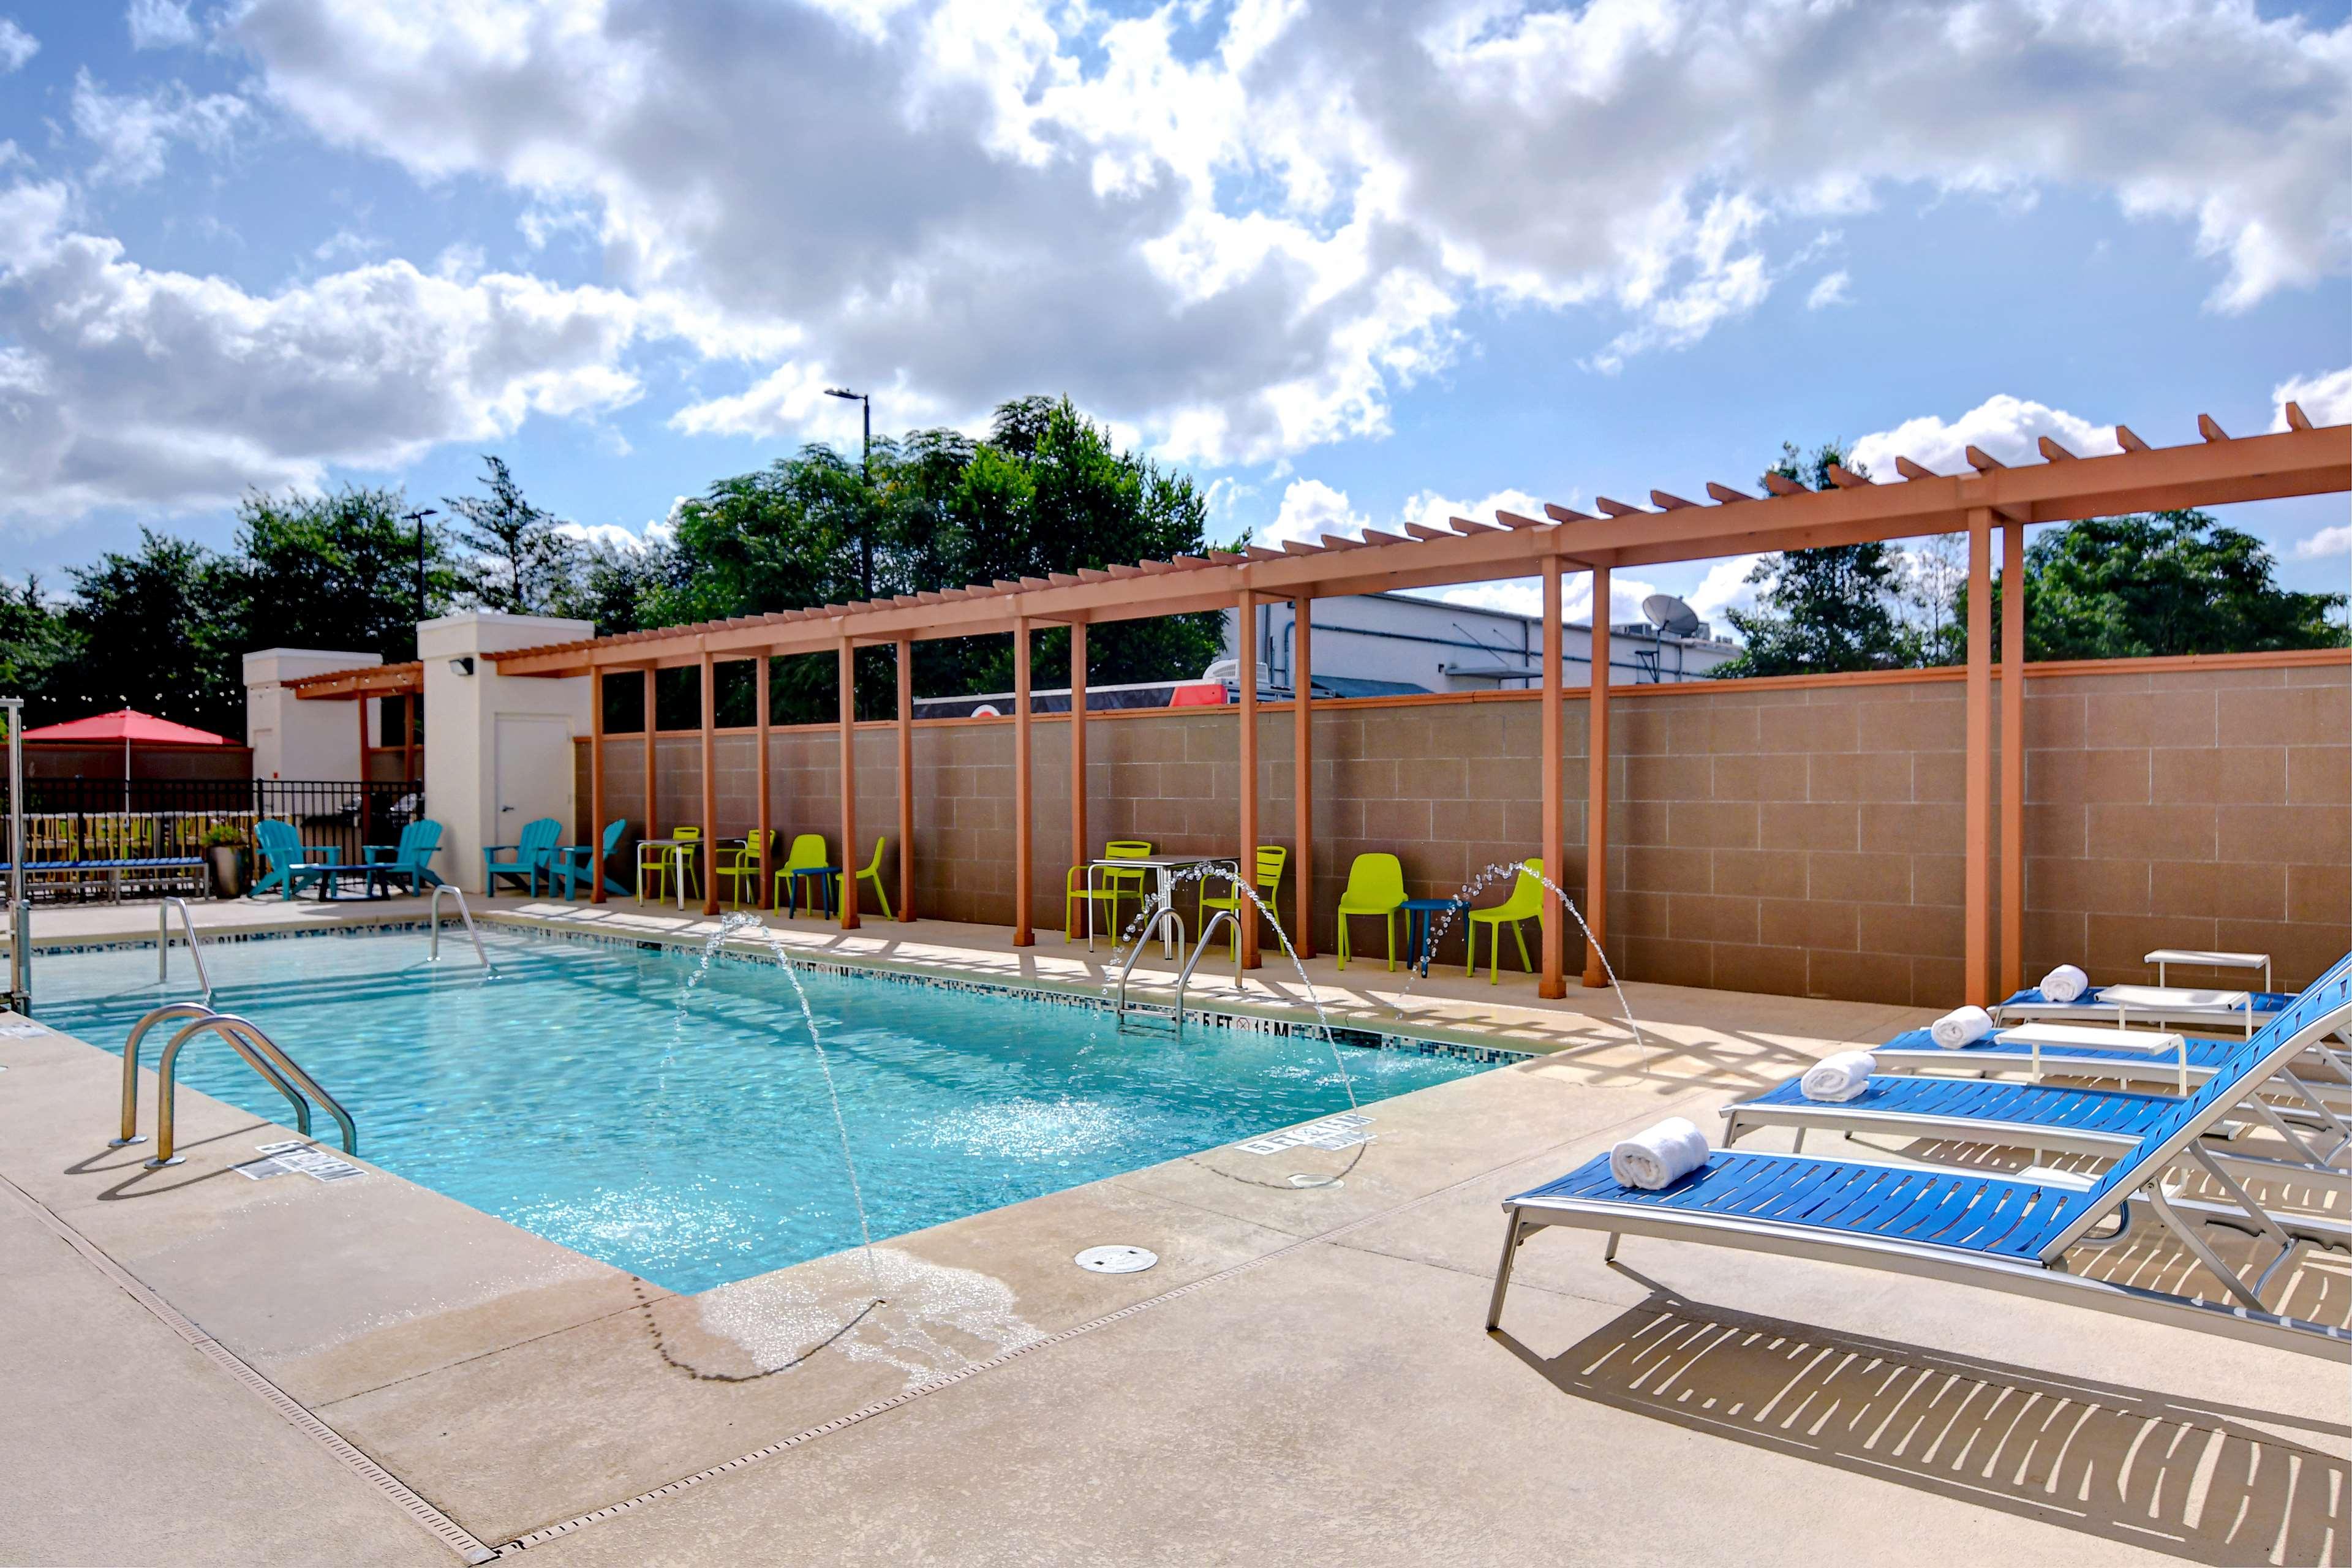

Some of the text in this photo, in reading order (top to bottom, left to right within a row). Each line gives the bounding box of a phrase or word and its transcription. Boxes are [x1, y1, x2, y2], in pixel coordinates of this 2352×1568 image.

[1217, 1014, 1232, 1029] FT
[1275, 1022, 1289, 1038] M
[1265, 1134, 1305, 1146] FT
